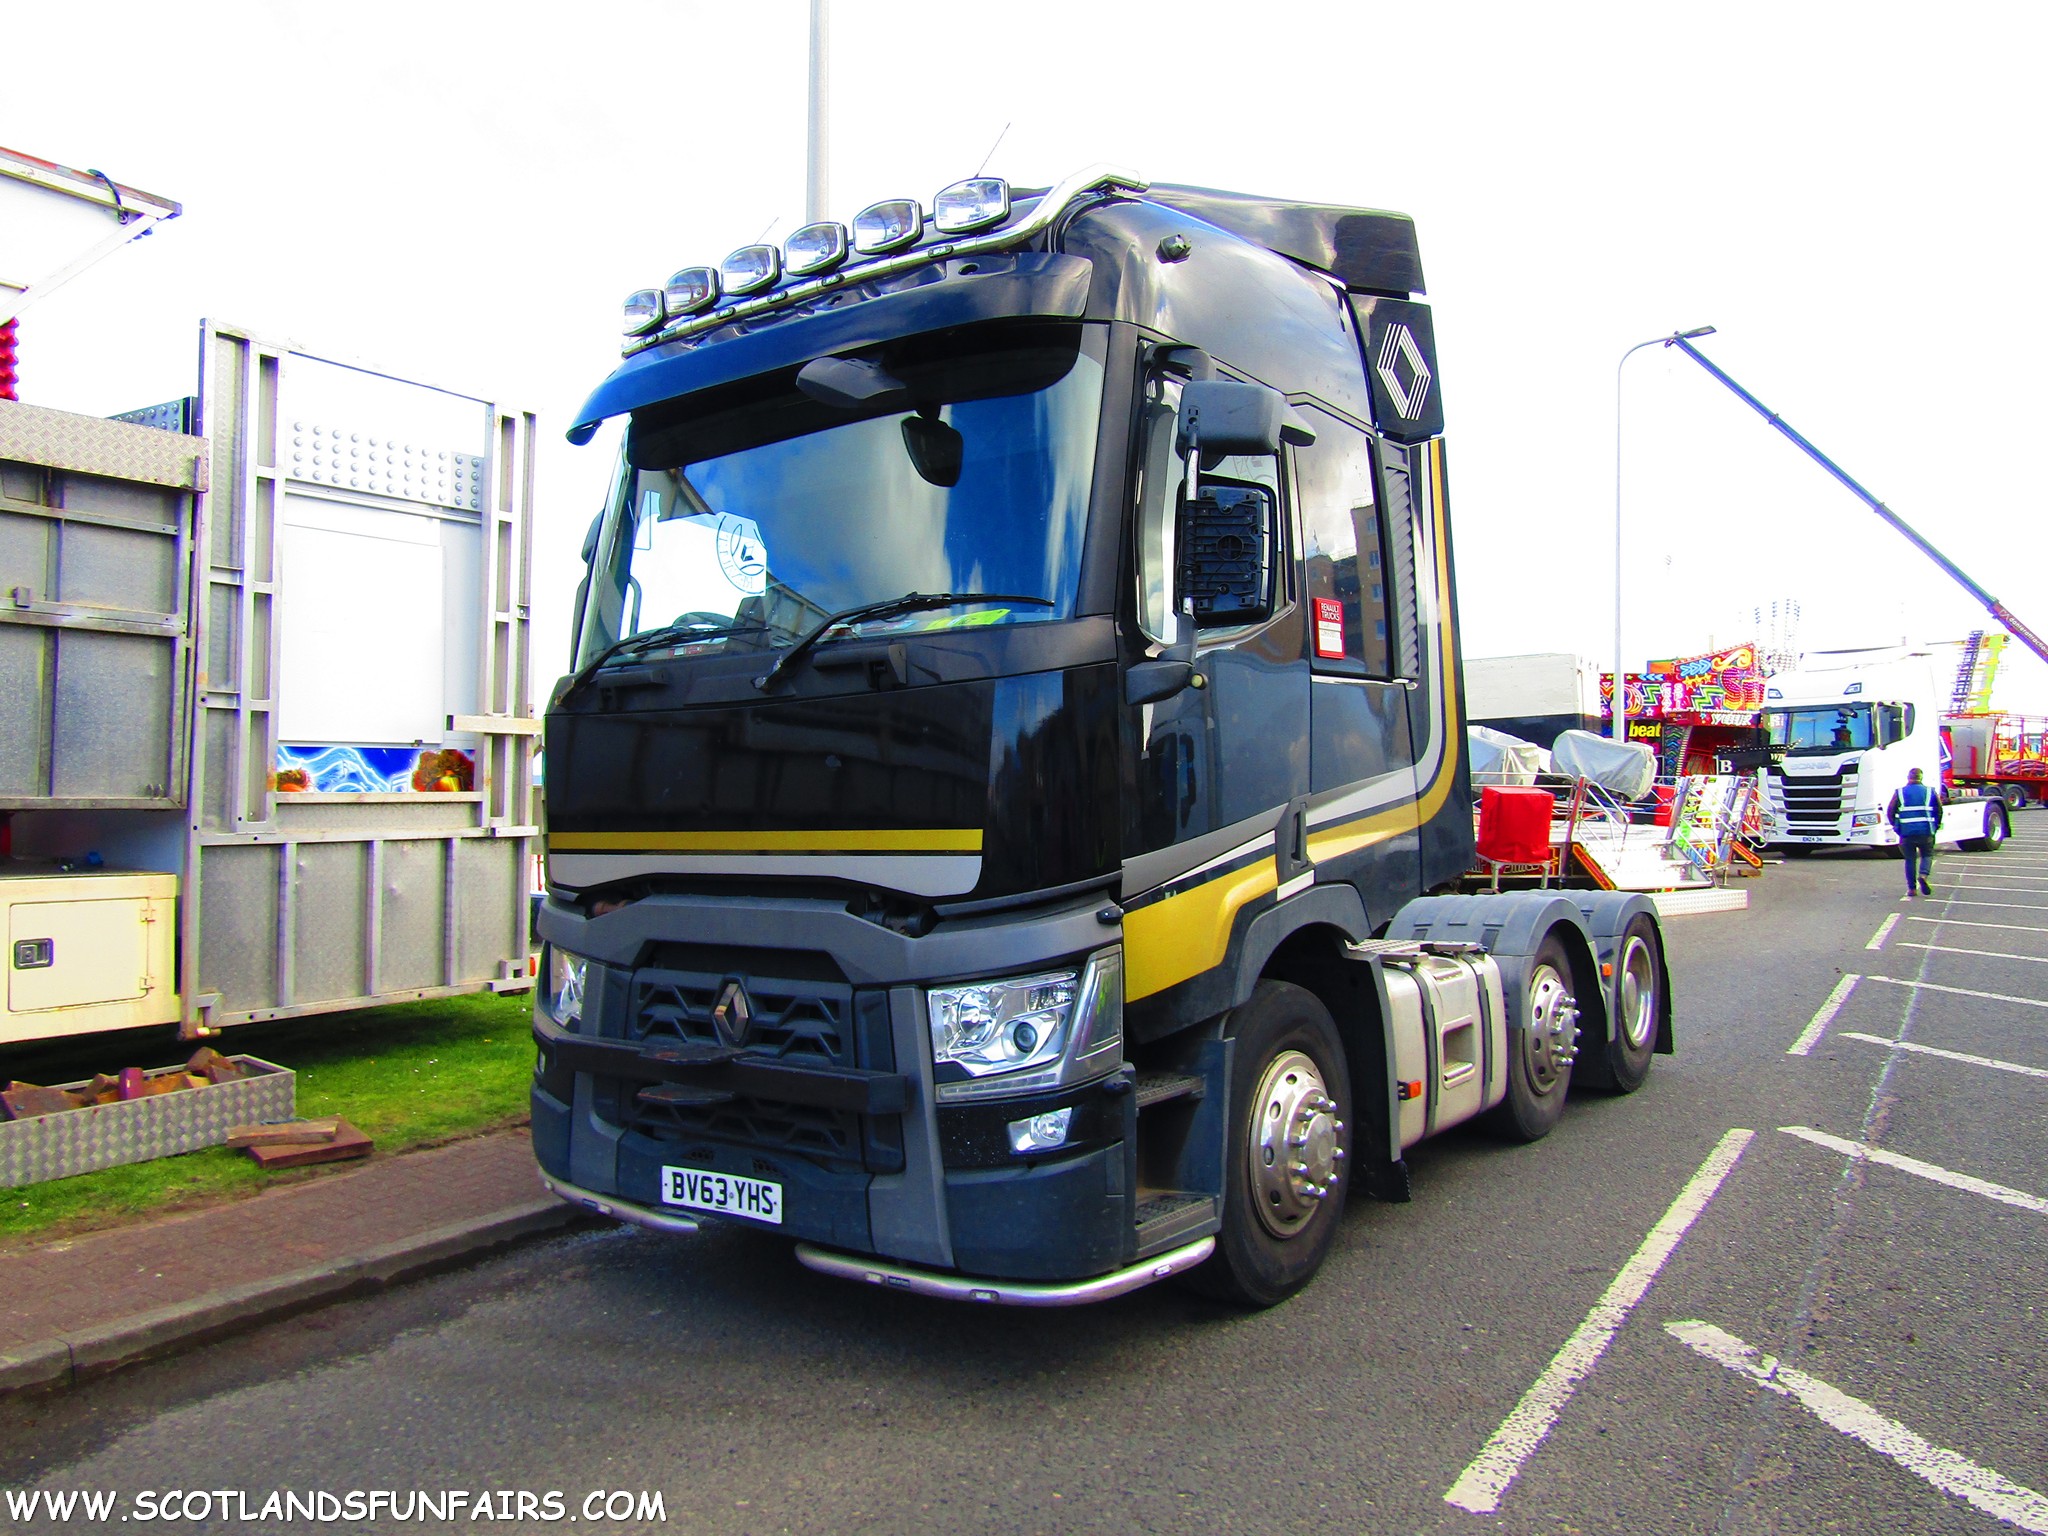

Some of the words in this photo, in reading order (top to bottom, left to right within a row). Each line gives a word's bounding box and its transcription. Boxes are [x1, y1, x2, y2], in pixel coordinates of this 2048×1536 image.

[1321, 602, 1340, 613] RENAULT
[1321, 610, 1340, 621] TRUCKS
[1628, 721, 1661, 738] beat
[1790, 762, 1832, 770] SCANIA
[671, 1172, 728, 1206] BV63
[734, 1180, 774, 1215] YHS
